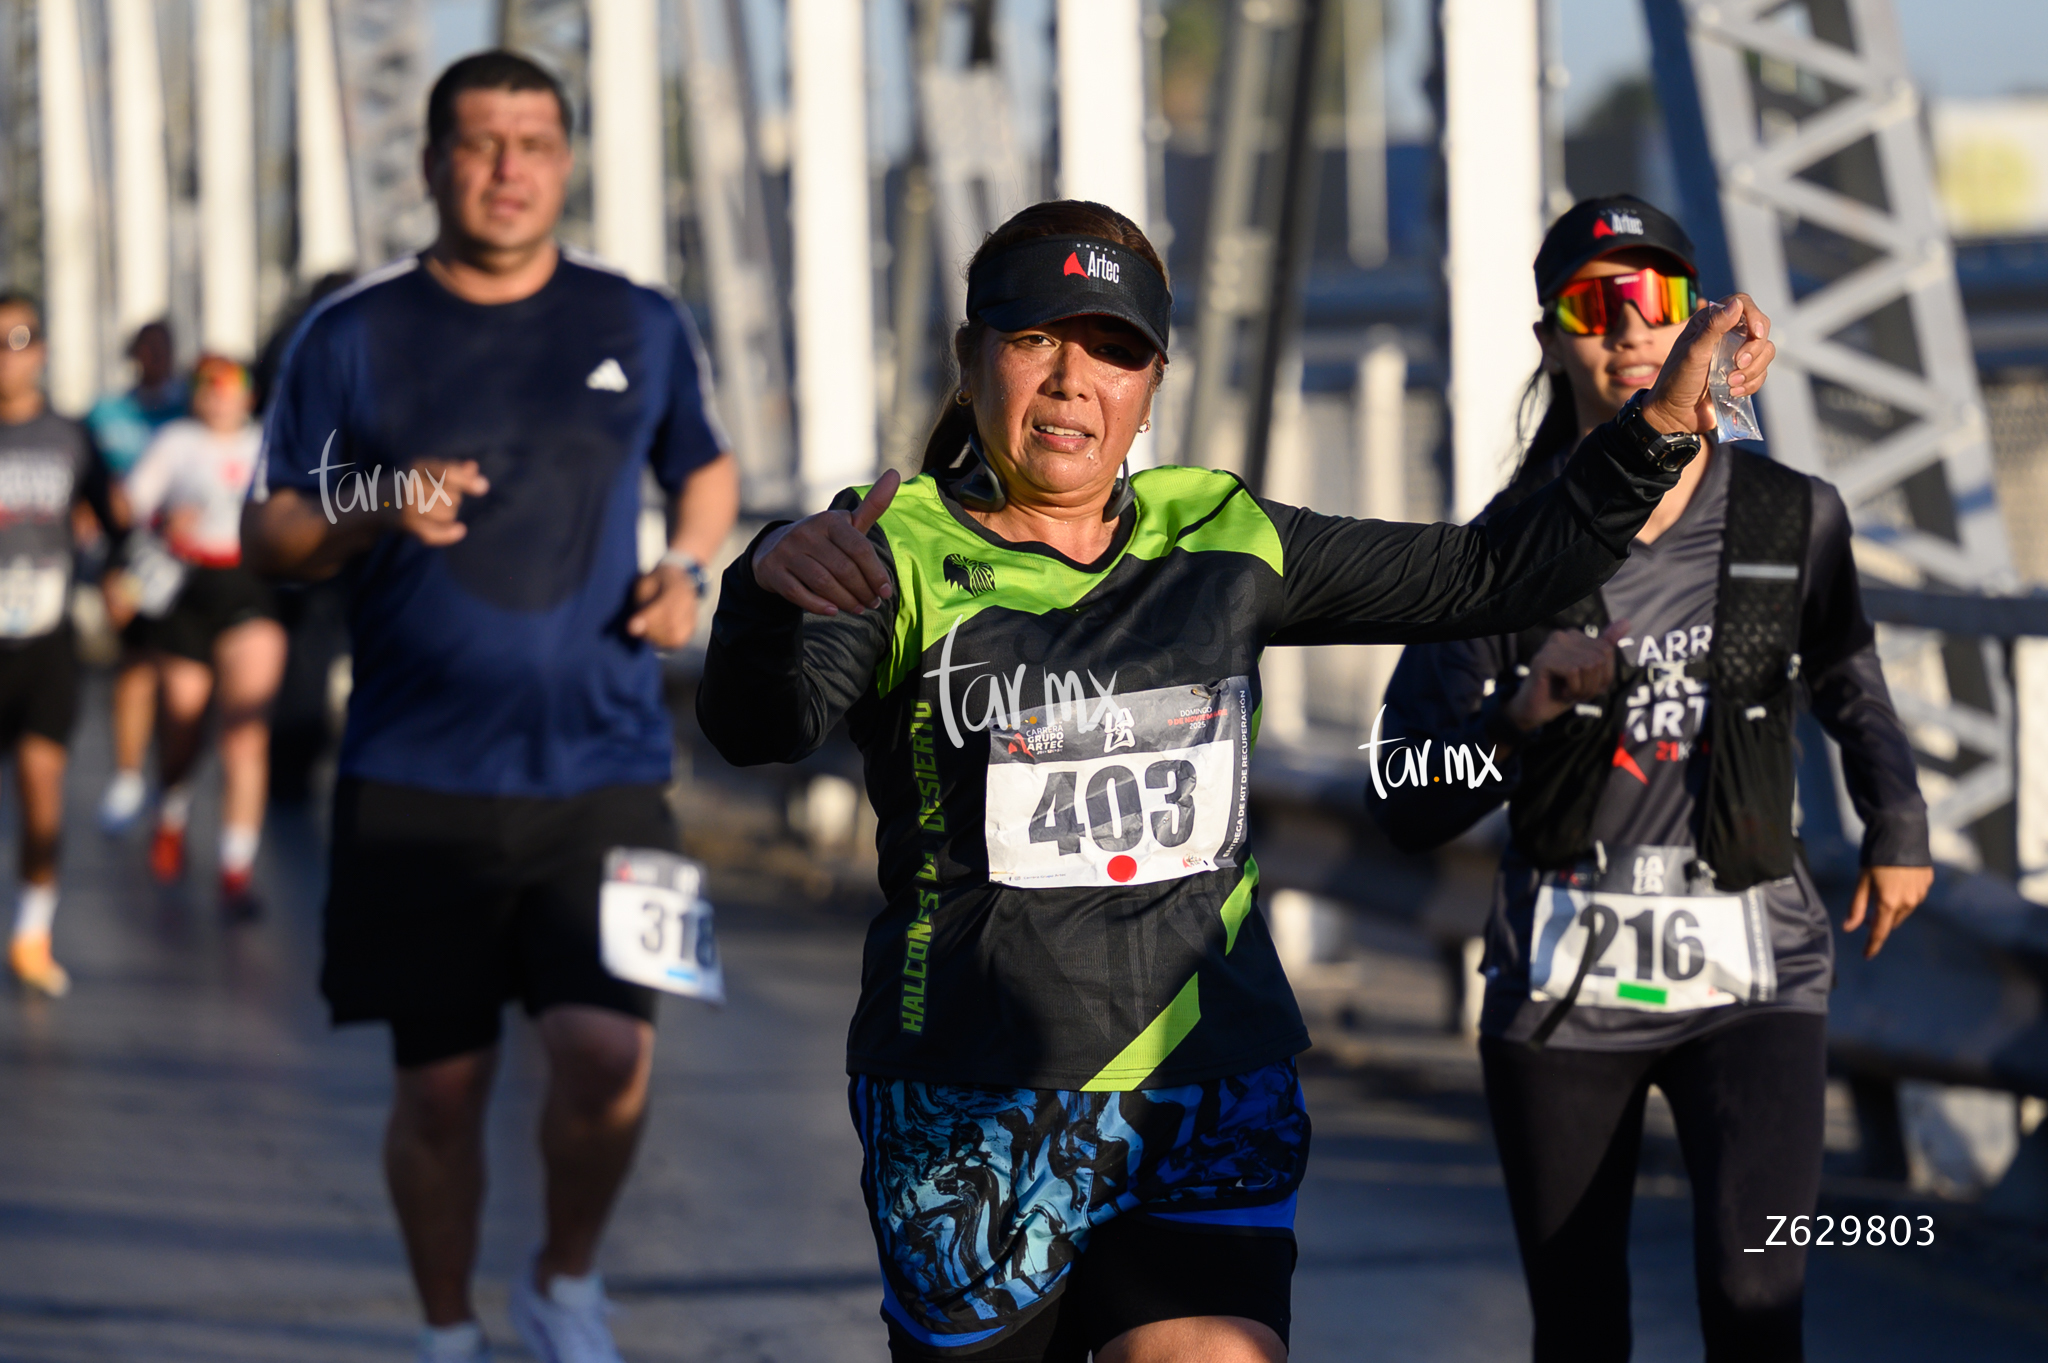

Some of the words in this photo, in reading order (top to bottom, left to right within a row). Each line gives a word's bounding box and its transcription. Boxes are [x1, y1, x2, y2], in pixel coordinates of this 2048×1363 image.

[1087, 251, 1120, 284] Artec
[1180, 706, 1212, 717] DOMINGO
[1167, 718, 1173, 726] 9
[1189, 721, 1206, 730] 2025
[1239, 690, 1248, 768] RECUPERACIÓN
[1026, 724, 1064, 737] CARRERA
[1027, 731, 1064, 743] GRUPO
[1026, 740, 1064, 752] ARTEC
[910, 700, 946, 832] DESIERTO
[1240, 770, 1248, 784] DE
[1028, 760, 1197, 856] 403
[1238, 802, 1245, 817] DE
[1222, 818, 1244, 858] ENTREGA
[1580, 904, 1705, 981] 216
